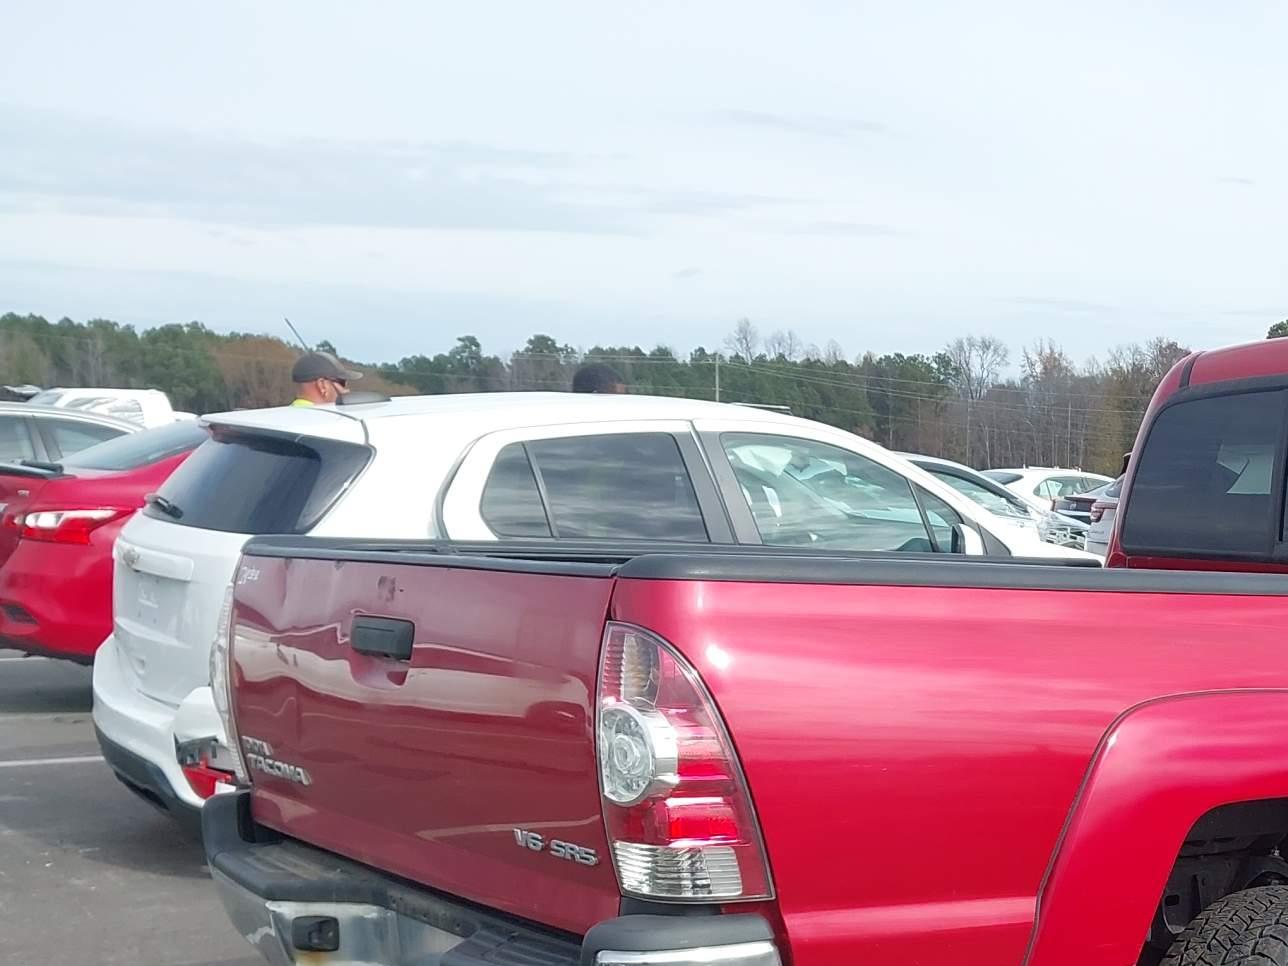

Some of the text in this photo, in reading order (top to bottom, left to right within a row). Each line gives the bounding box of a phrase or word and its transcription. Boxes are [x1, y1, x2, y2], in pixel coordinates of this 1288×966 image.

[247, 753, 312, 785] TACOMA
[513, 828, 598, 866] V6 SR5
